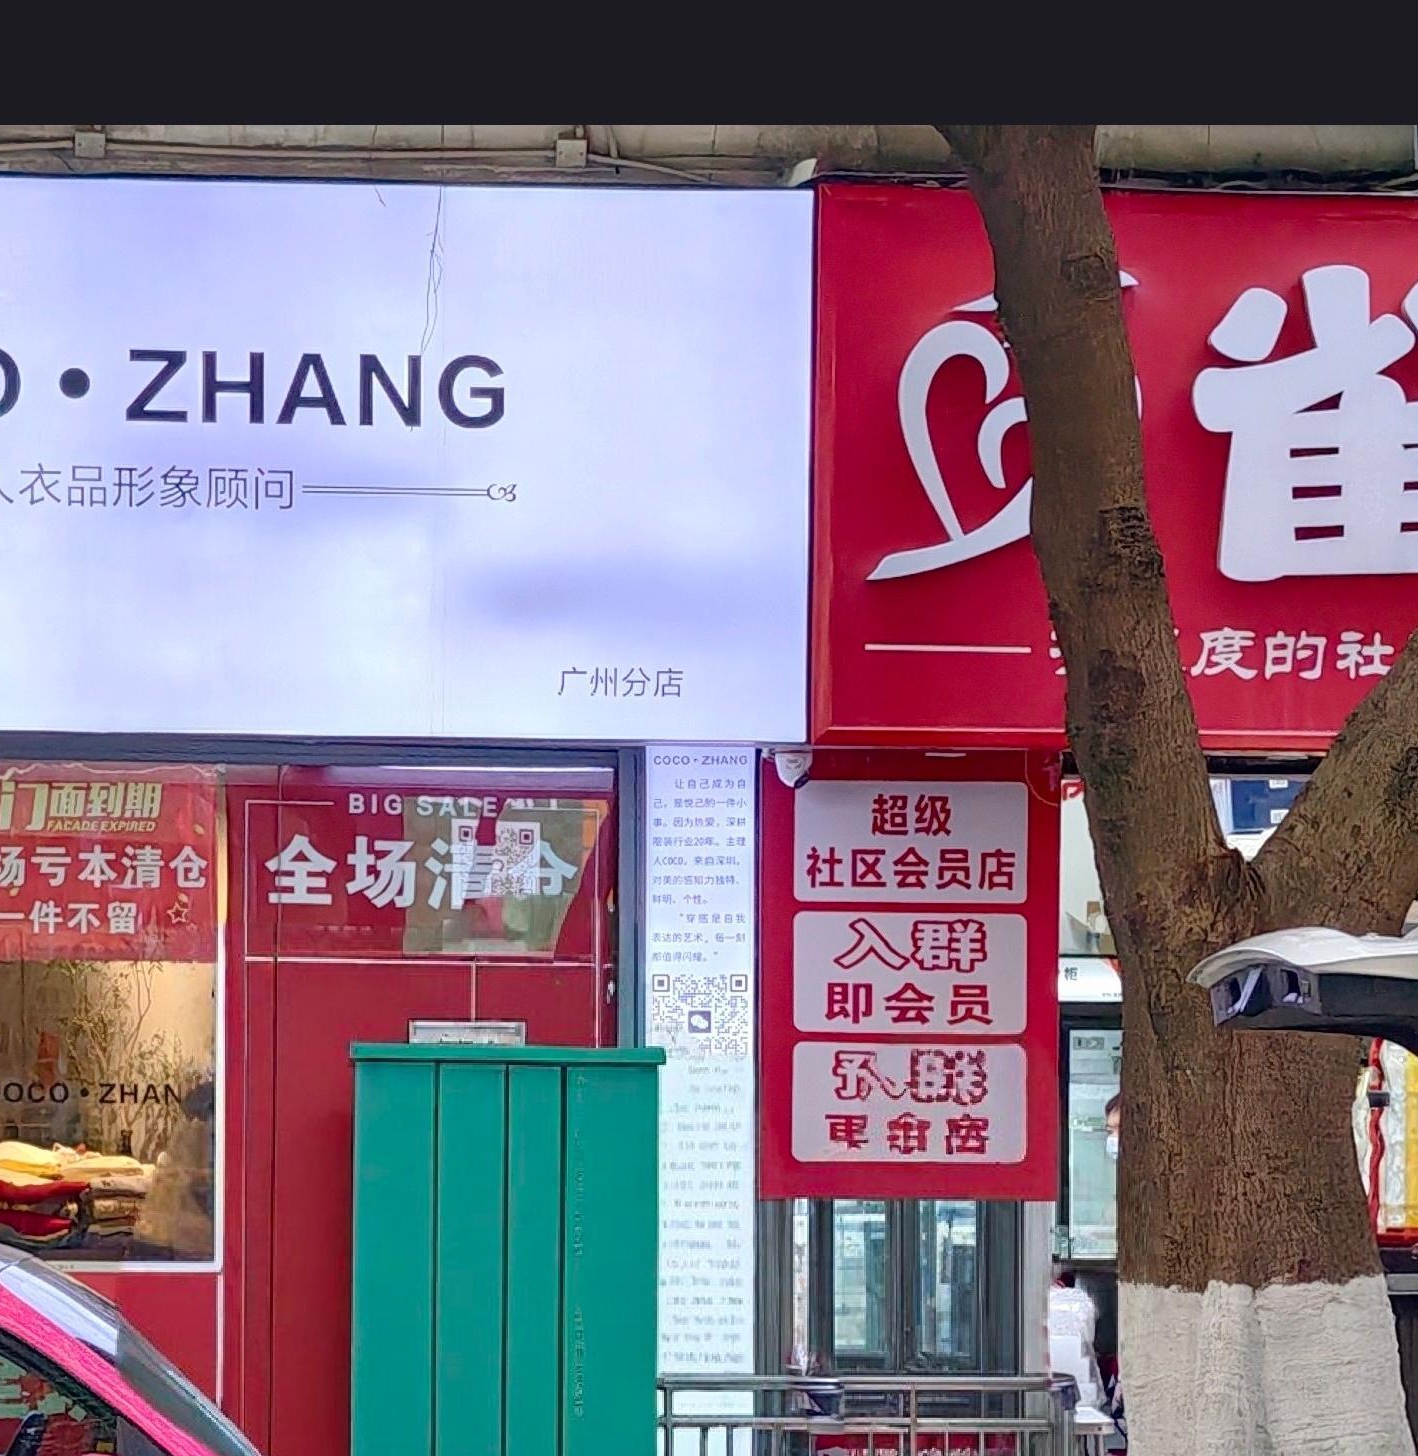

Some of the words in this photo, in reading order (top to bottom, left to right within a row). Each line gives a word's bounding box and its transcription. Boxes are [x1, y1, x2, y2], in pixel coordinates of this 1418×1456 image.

[125, 348, 507, 430] ZHANG
[557, 664, 685, 700] 广州分店
[653, 755, 691, 766] COCO
[701, 755, 748, 766] ZHANG
[348, 793, 403, 816] BIG
[416, 795, 499, 818] SALE
[871, 793, 952, 837] 超级
[805, 845, 1016, 891] 社区会员店
[833, 917, 987, 973] 入群
[824, 981, 994, 1026] 即会员
